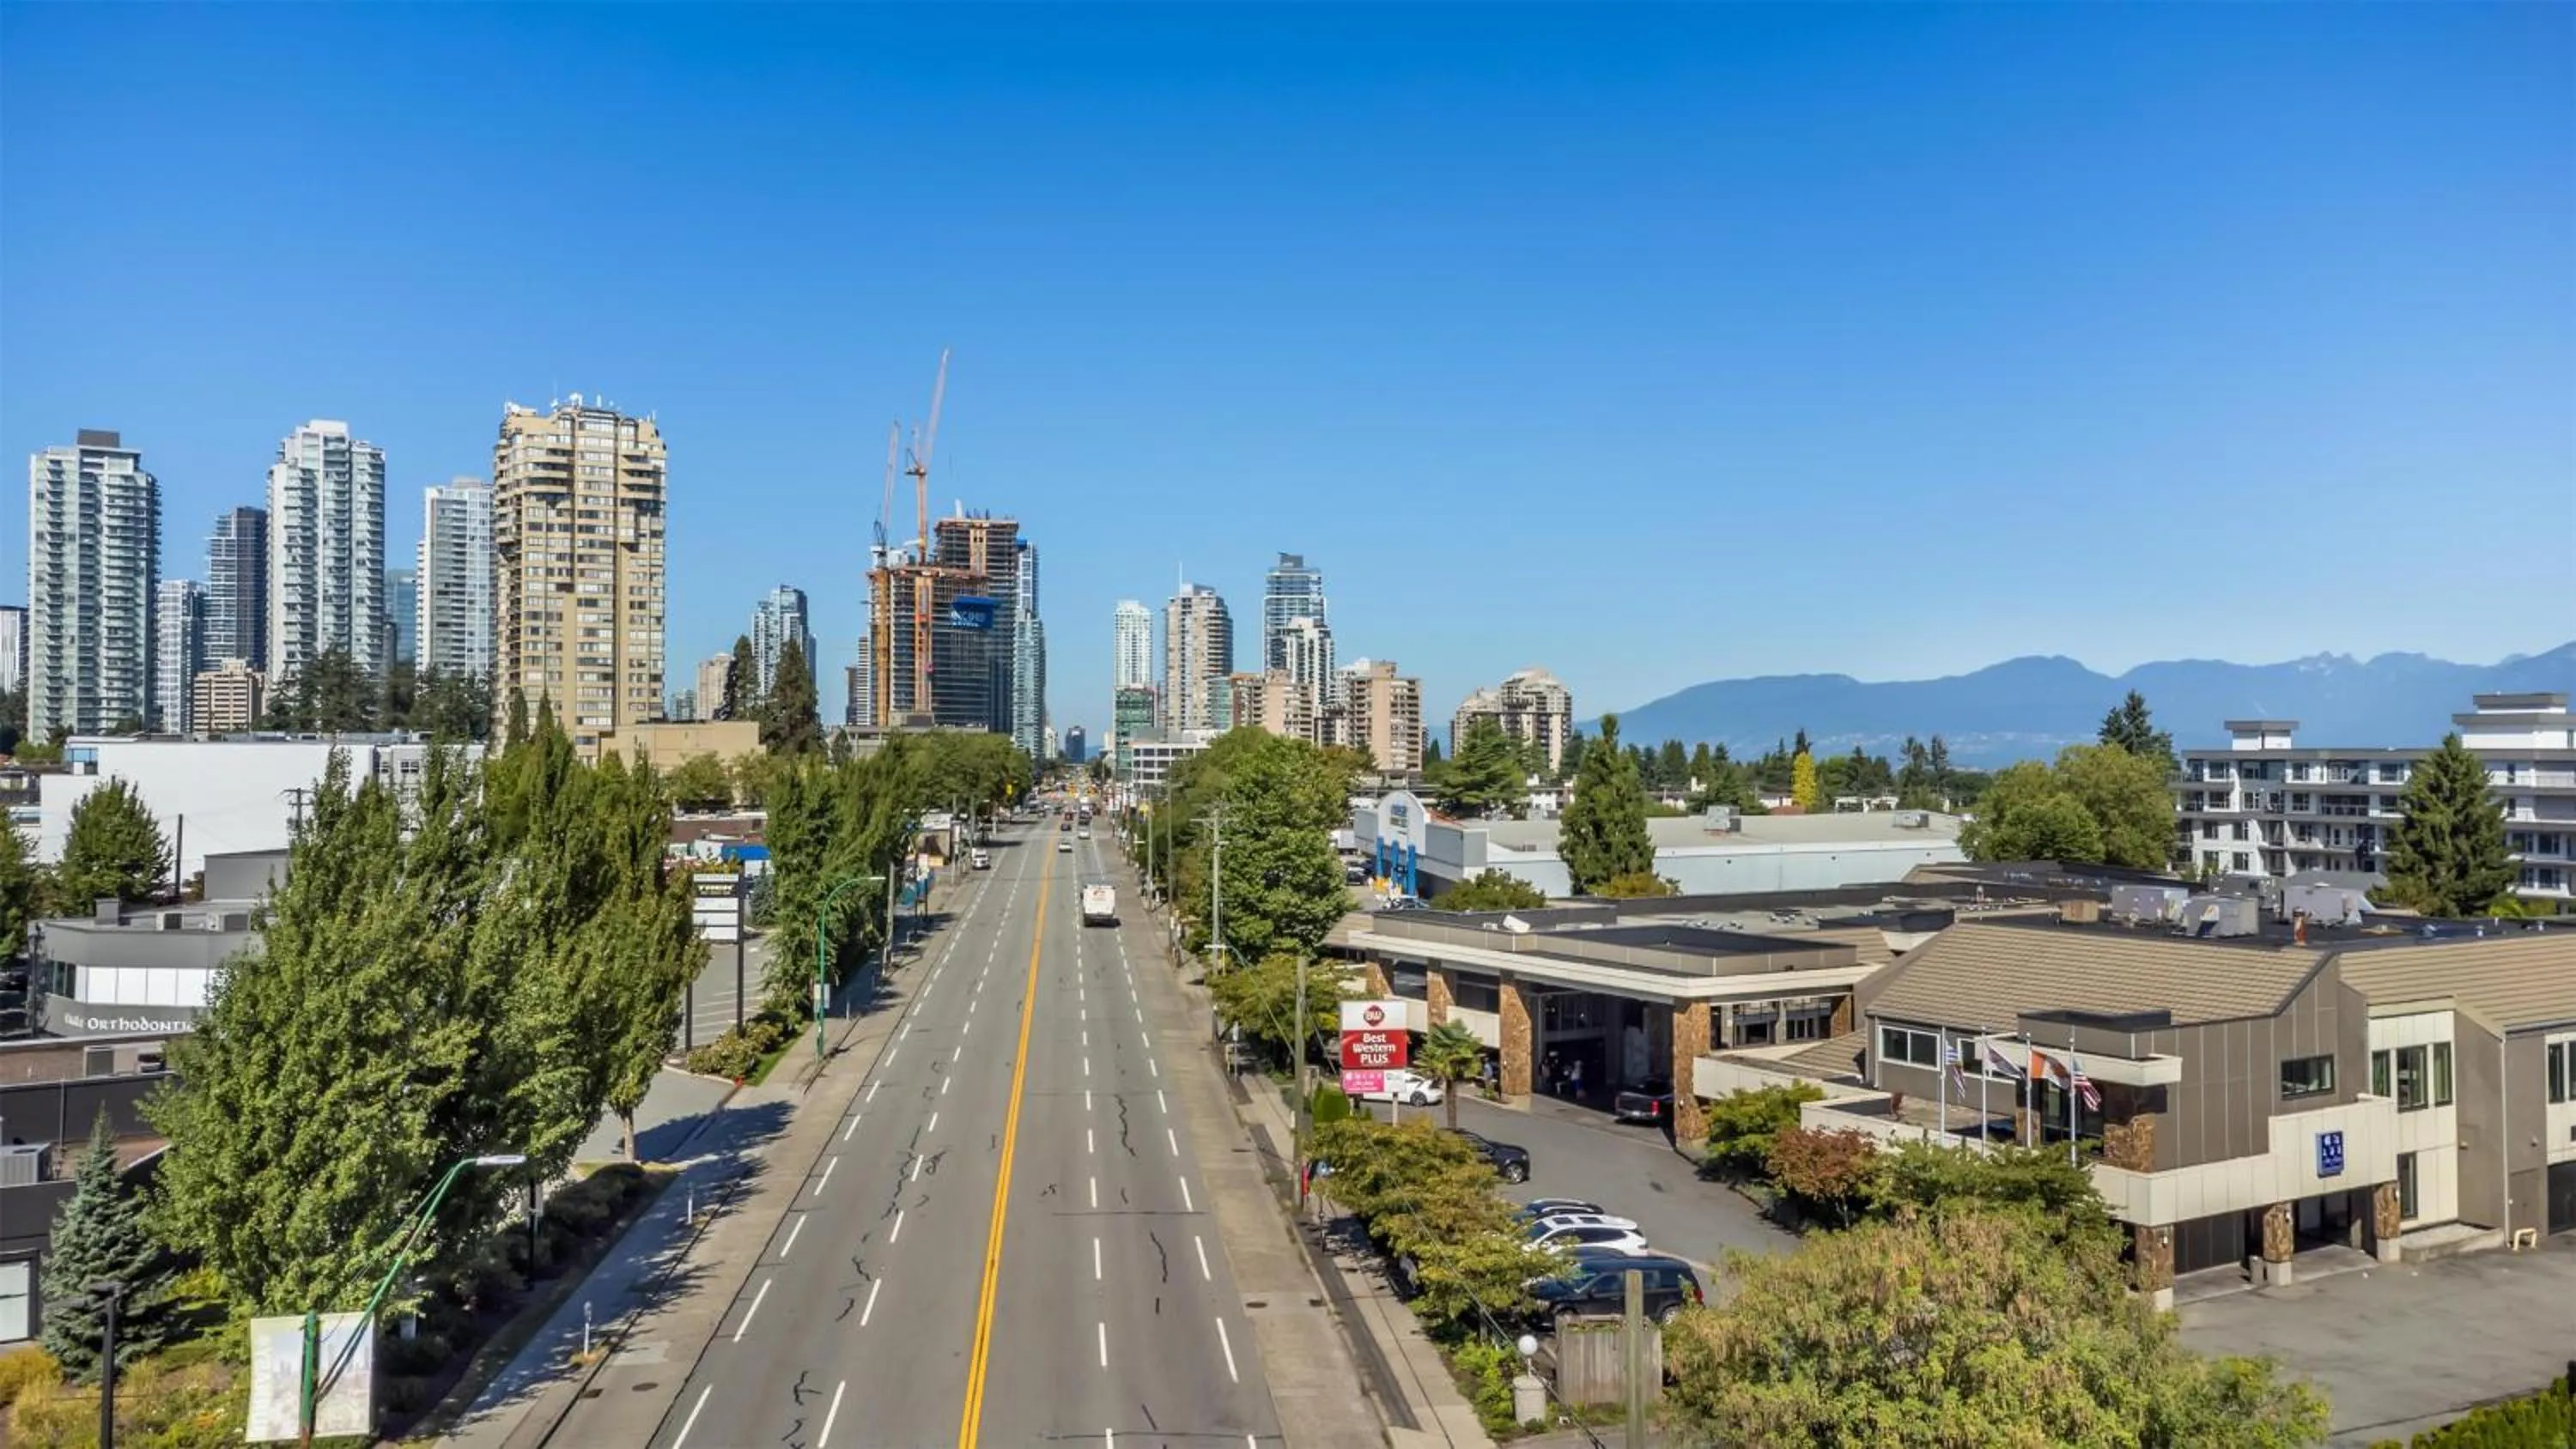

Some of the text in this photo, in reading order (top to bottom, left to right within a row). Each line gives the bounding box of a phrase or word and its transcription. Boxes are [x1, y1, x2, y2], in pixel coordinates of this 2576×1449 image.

[1363, 1033, 1387, 1043] Best
[1352, 1043, 1396, 1053] Western
[1360, 1053, 1389, 1064] PLUS
